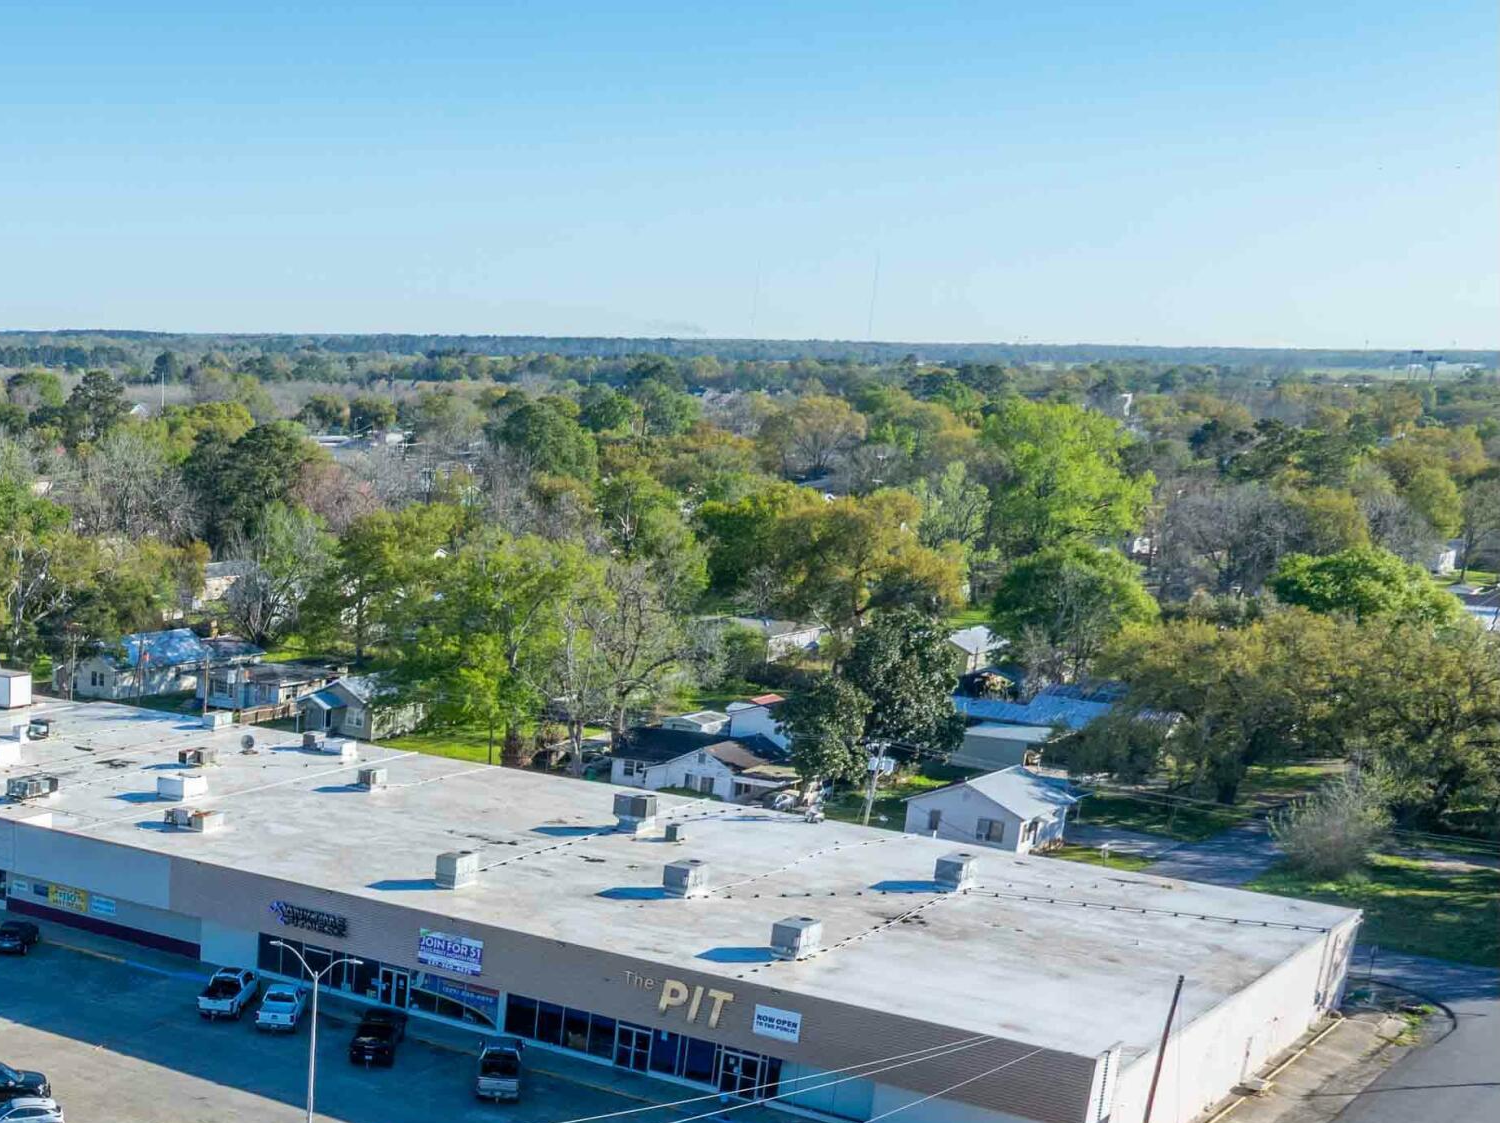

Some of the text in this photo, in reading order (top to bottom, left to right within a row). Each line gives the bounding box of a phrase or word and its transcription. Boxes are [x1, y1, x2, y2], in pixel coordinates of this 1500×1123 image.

[420, 936, 480, 958] JOIN FOR $1
[623, 970, 735, 1029] The PIT
[757, 1014, 798, 1028] NOW OPEN
[776, 1026, 796, 1034] PUBLIC
